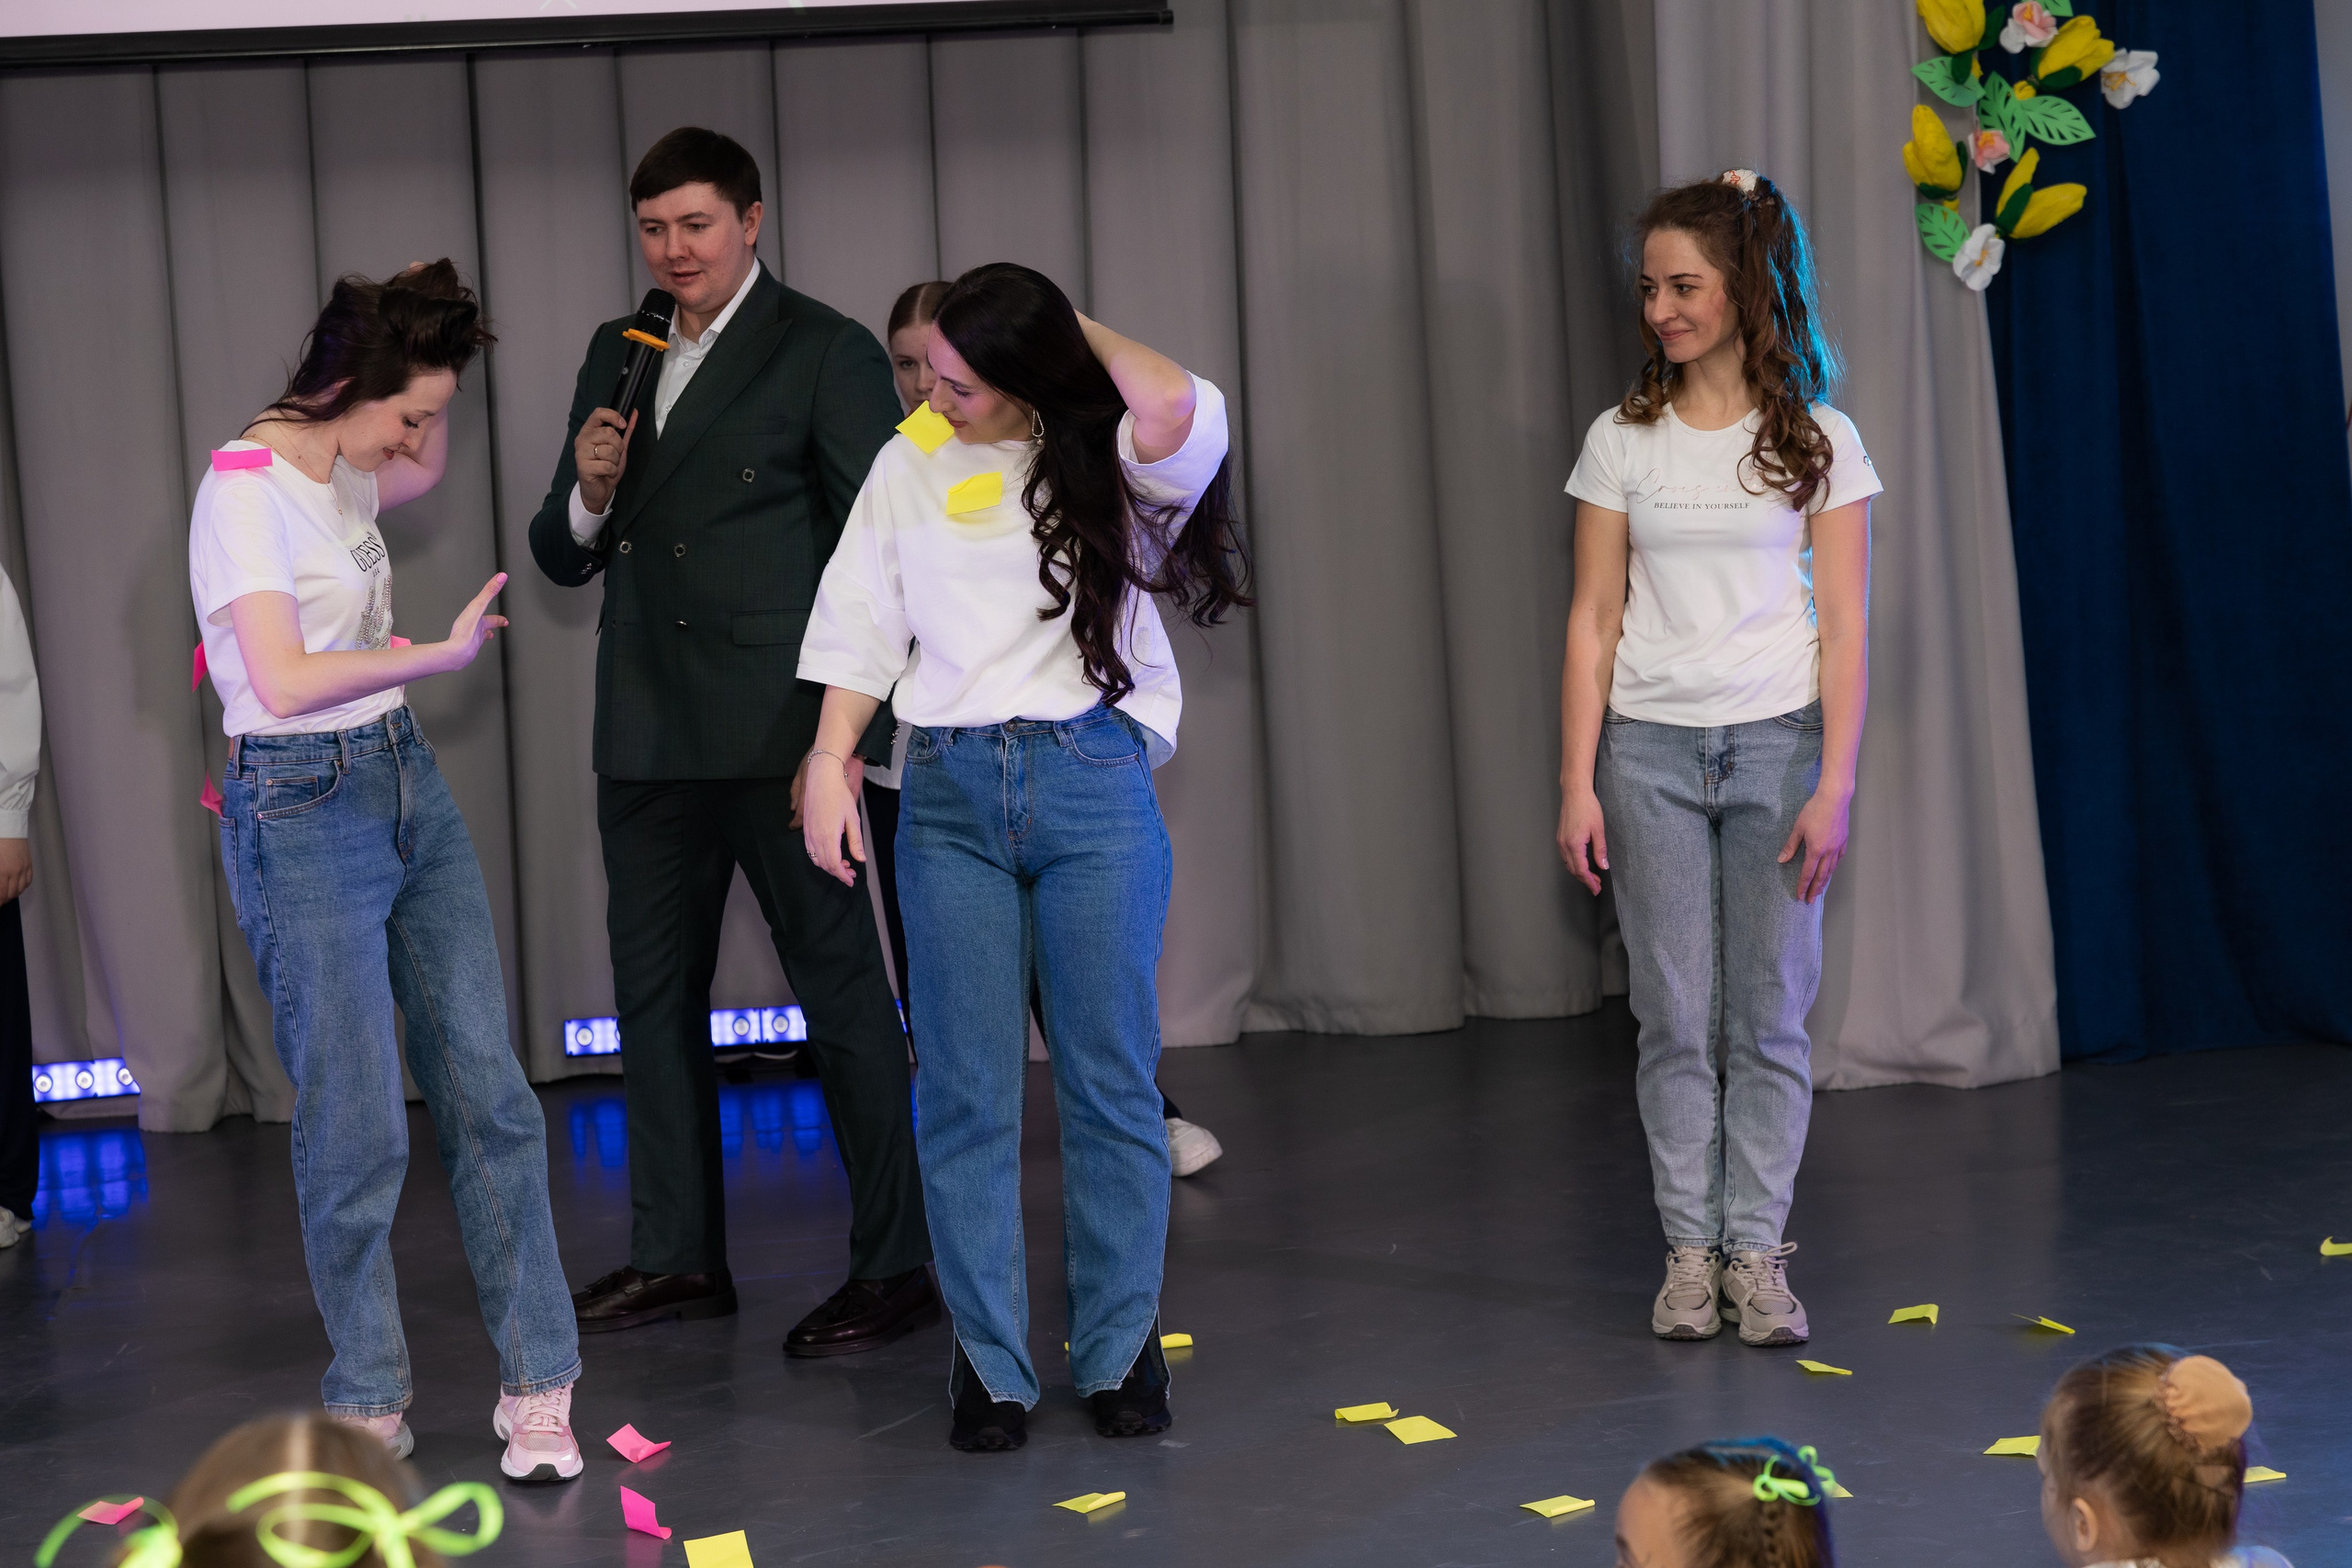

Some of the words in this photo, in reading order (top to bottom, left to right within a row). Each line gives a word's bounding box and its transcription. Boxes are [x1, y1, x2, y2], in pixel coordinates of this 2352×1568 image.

[1654, 502, 1690, 510] BELIEVE
[1704, 502, 1750, 510] YOURSELF
[350, 536, 386, 572] GUESS
